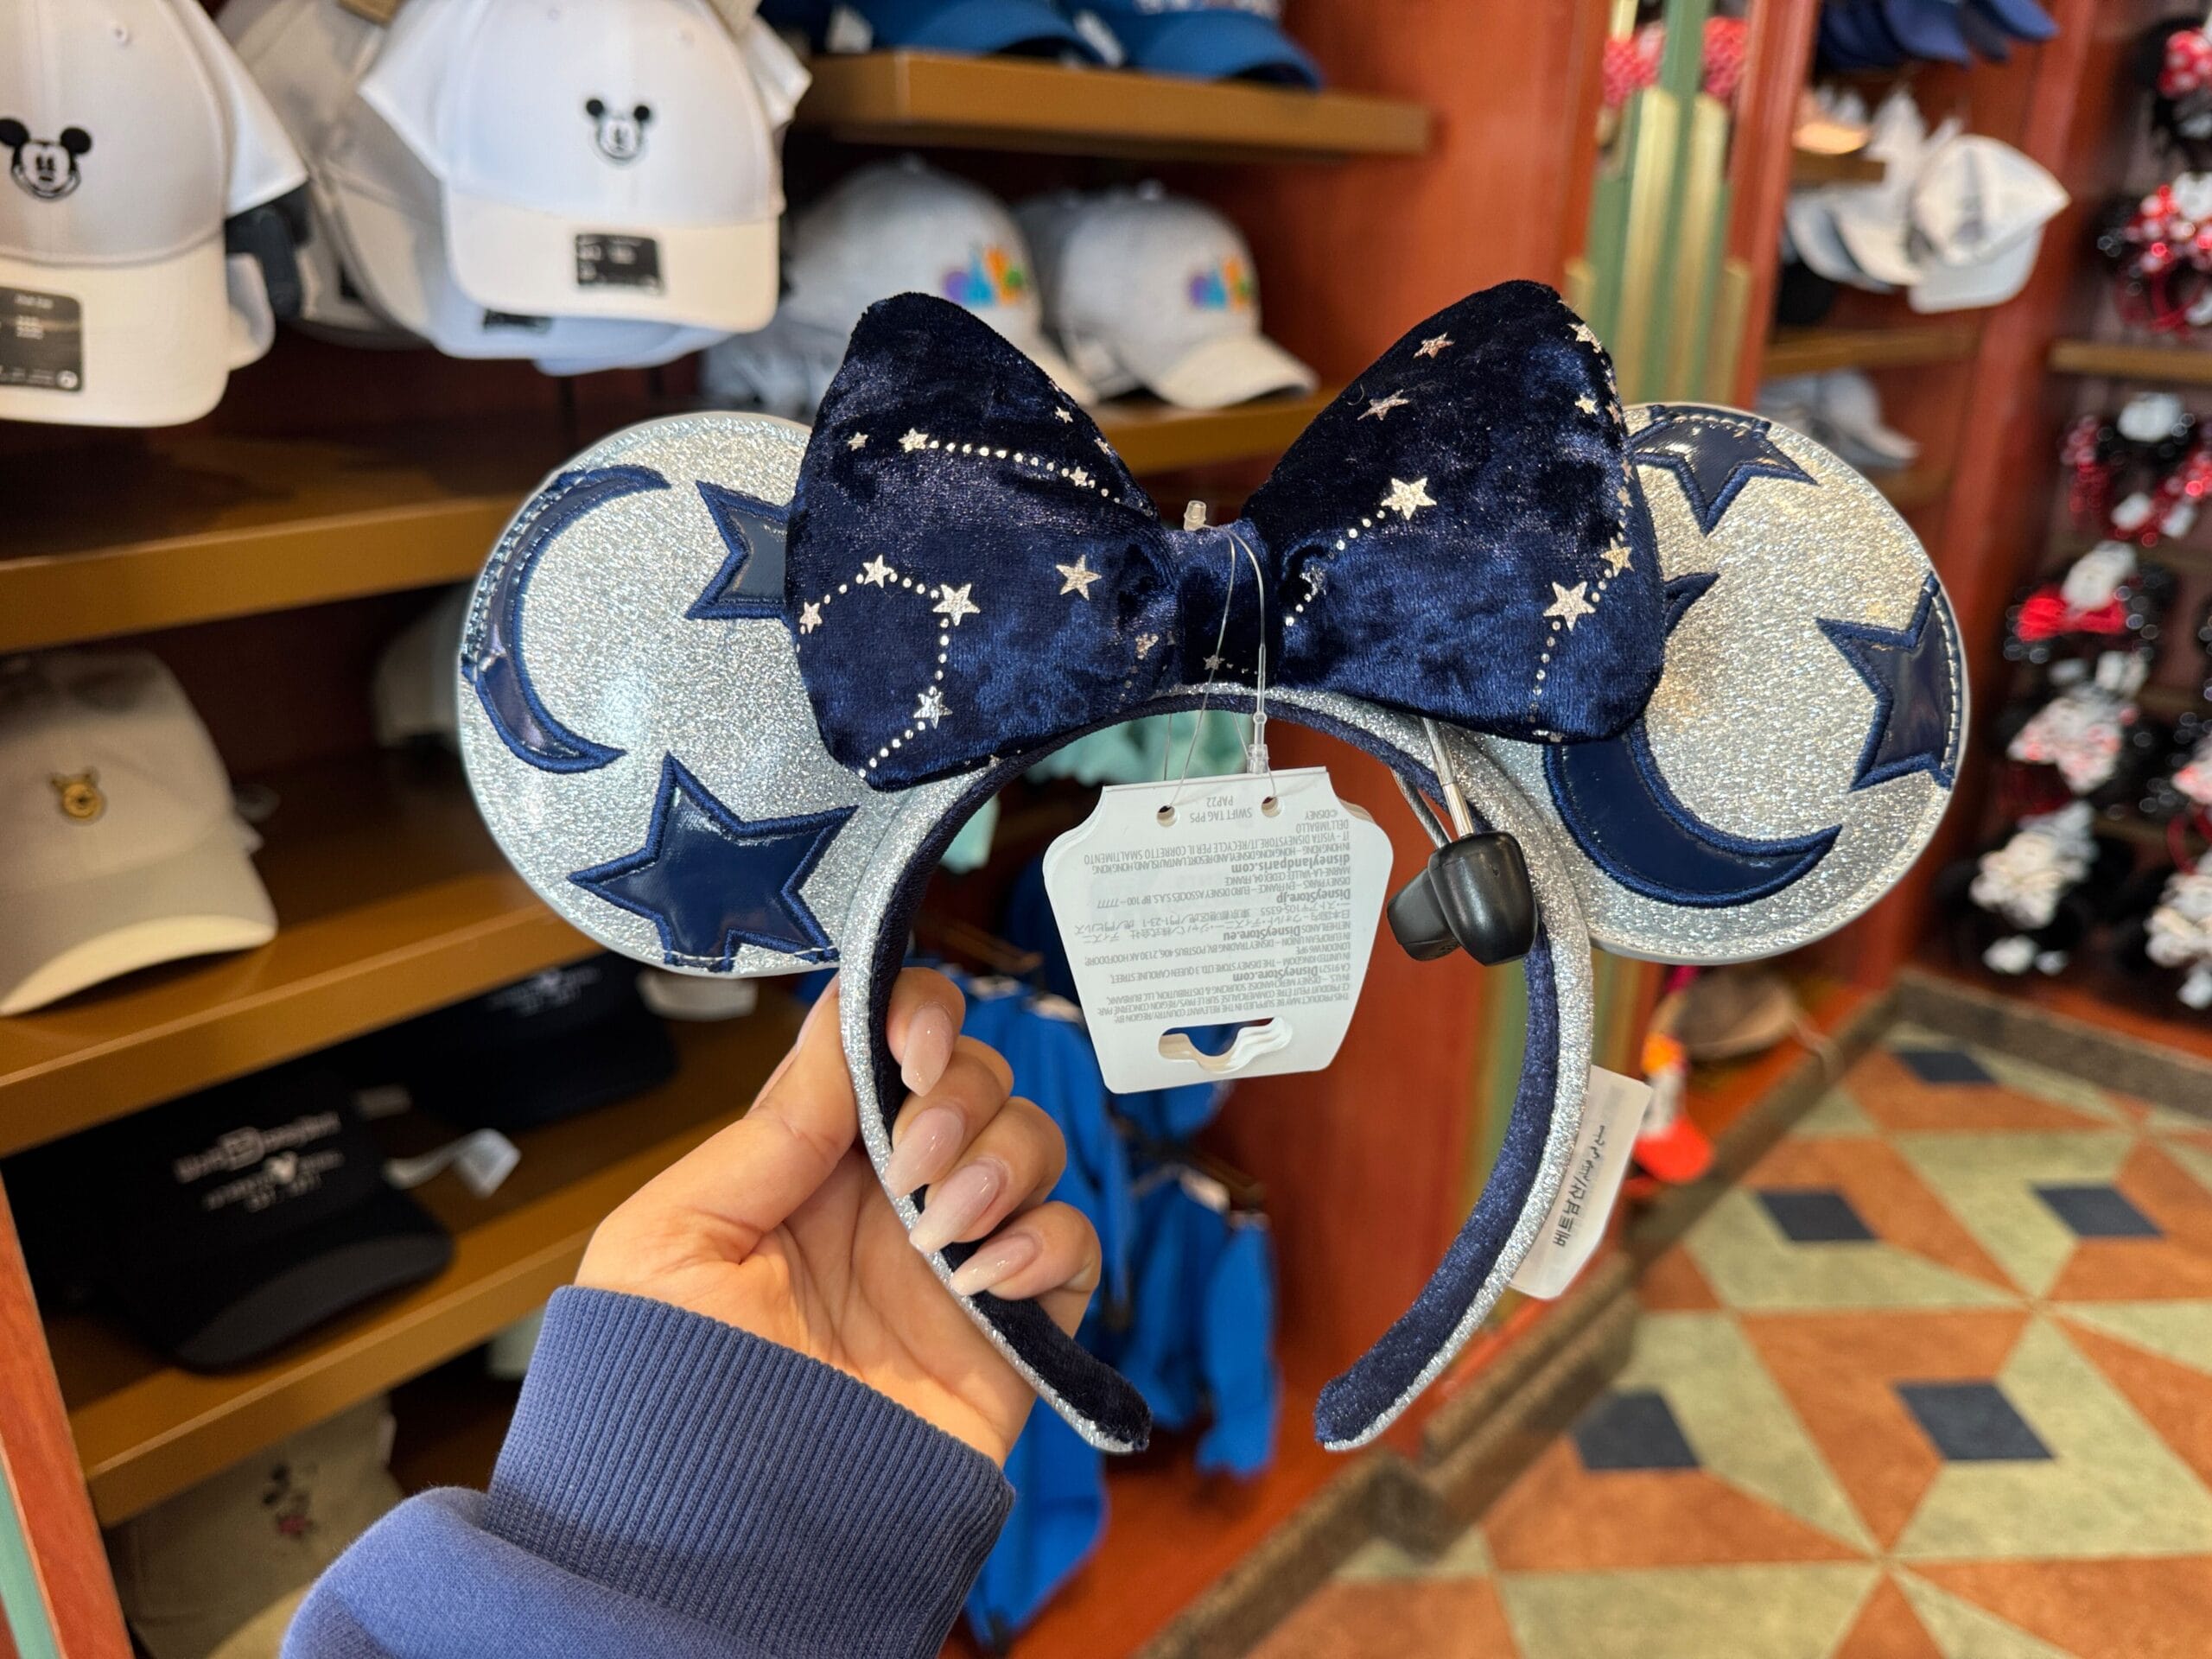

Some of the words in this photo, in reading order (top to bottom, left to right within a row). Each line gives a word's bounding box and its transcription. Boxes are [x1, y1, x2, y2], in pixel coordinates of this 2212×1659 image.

[1205, 795, 1233, 807] PAP22
[1189, 811, 1205, 823] PPS
[1207, 810, 1224, 821] TAG
[1225, 807, 1251, 819] SWIFT
[1312, 831, 1335, 843] VISITA
[1342, 830, 1349, 841] IT
[1186, 844, 1195, 855] IL
[1196, 842, 1211, 854] PER
[1212, 834, 1310, 853] DISNEYSTORE.IT/RECYCLE
[1084, 849, 1142, 864] SMALTIMENTO
[1144, 845, 1185, 859] CORRETTO
[1230, 851, 1350, 875] disneylandparis.com
[1275, 886, 1351, 906] DisneyStore.jp
[1222, 923, 1300, 942] DisneyStore.eu
[1232, 963, 1318, 982] DisneyStore.com
